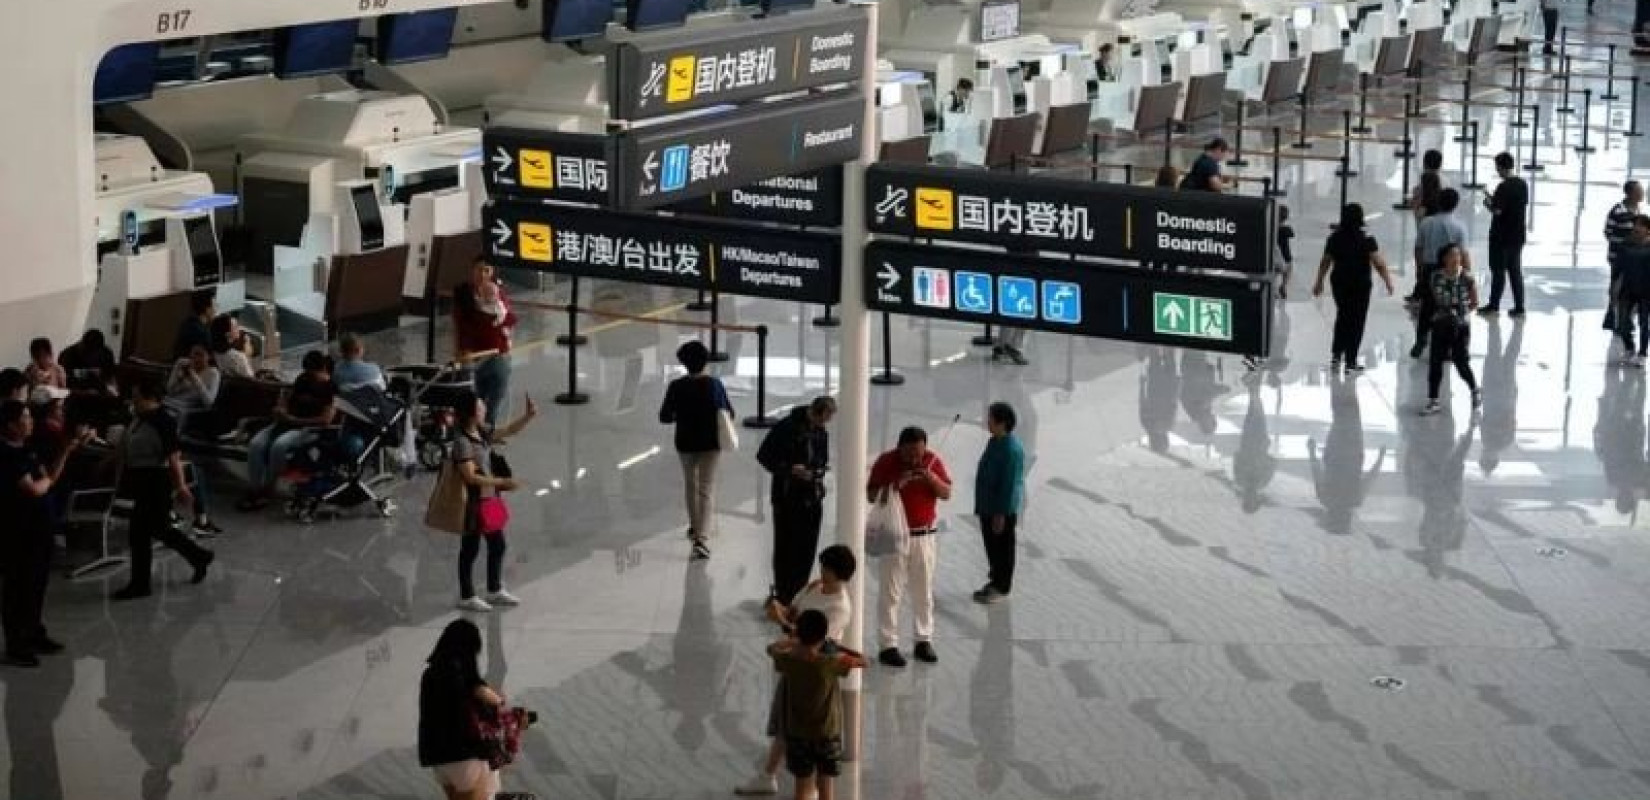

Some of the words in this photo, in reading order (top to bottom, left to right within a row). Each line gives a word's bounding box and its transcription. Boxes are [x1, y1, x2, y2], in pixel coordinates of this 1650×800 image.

[157, 10, 191, 33] B17
[812, 33, 854, 51] Domestic
[696, 46, 776, 93] 国内登机
[811, 54, 852, 73] Boarding
[804, 124, 853, 147] Restaurant
[691, 139, 731, 181] 餐饮
[732, 189, 813, 212] Departures
[958, 194, 1095, 242] 国内登机
[1156, 211, 1237, 235] Domestic
[557, 230, 701, 277] 港/澳/台出发
[722, 246, 819, 270] HK/Macao/Taiwan
[1158, 232, 1236, 260] Boarding
[741, 267, 803, 287] Departures
